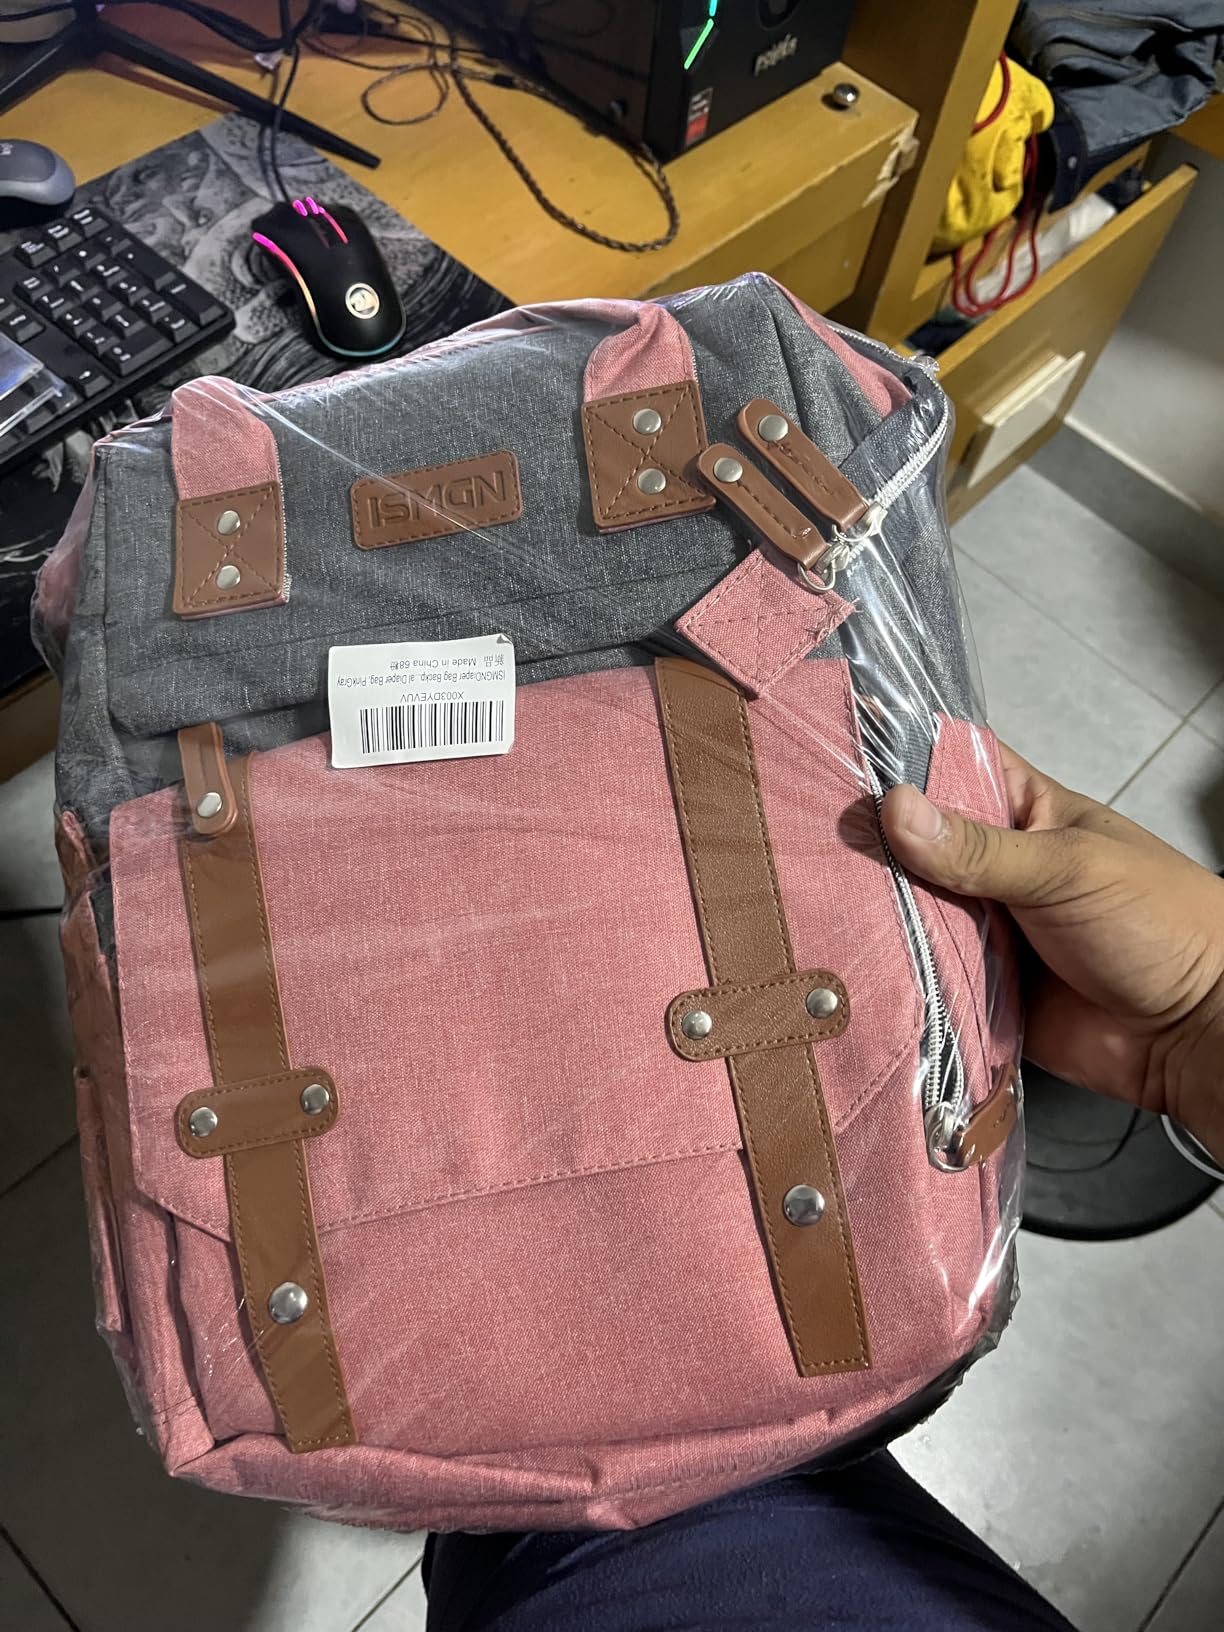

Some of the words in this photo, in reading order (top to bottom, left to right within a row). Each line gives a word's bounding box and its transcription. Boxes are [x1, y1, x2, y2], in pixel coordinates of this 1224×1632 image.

[413, 659, 439, 668] China
[441, 659, 450, 667] in
[452, 657, 476, 667] Made
[484, 653, 504, 668] 新品
[385, 673, 407, 684] Diaper
[444, 670, 457, 683] Bag
[400, 691, 464, 703] X003DYEVUV
